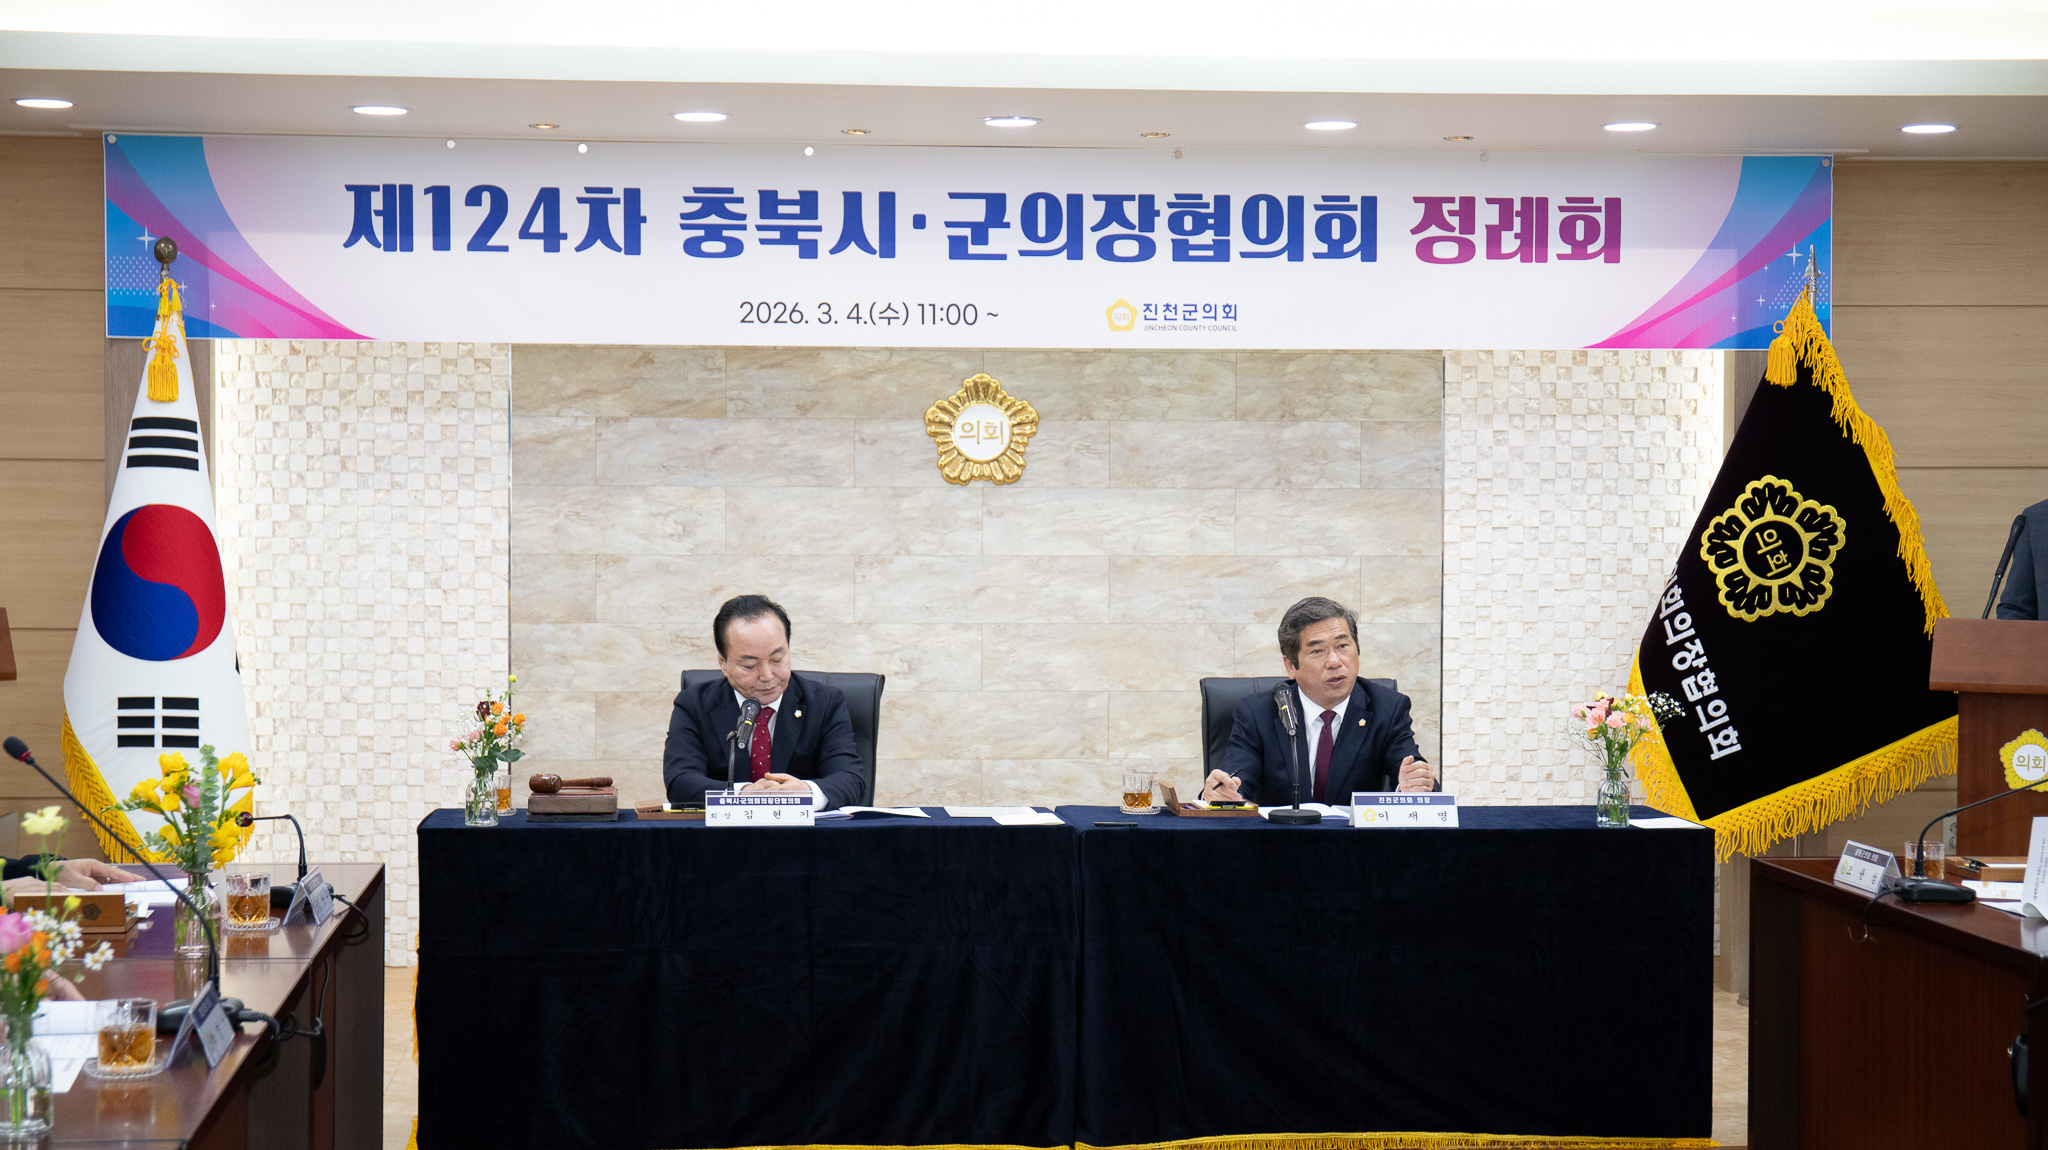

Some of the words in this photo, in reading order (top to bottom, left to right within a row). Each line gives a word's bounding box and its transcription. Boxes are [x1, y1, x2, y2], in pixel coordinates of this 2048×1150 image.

[343, 184, 648, 256] 제124차
[679, 186, 1378, 263] 충북시·군의장협의회
[1409, 196, 1622, 264] 정례회
[740, 301, 809, 325] 2026.
[817, 302, 839, 325] 3.
[846, 302, 909, 326] 4.(수)
[917, 303, 979, 326] 11:00
[1142, 302, 1238, 322] 진천군의회
[1144, 324, 1178, 332] JINCHEON
[1179, 324, 1207, 332] COUNTY
[1208, 324, 1238, 332] COUNCIL
[959, 419, 1004, 445] 의회
[1755, 528, 1792, 578] 의회
[2015, 753, 2047, 773] 의회
[1378, 796, 1413, 804] 진천군의회
[1416, 796, 1431, 804] 의장
